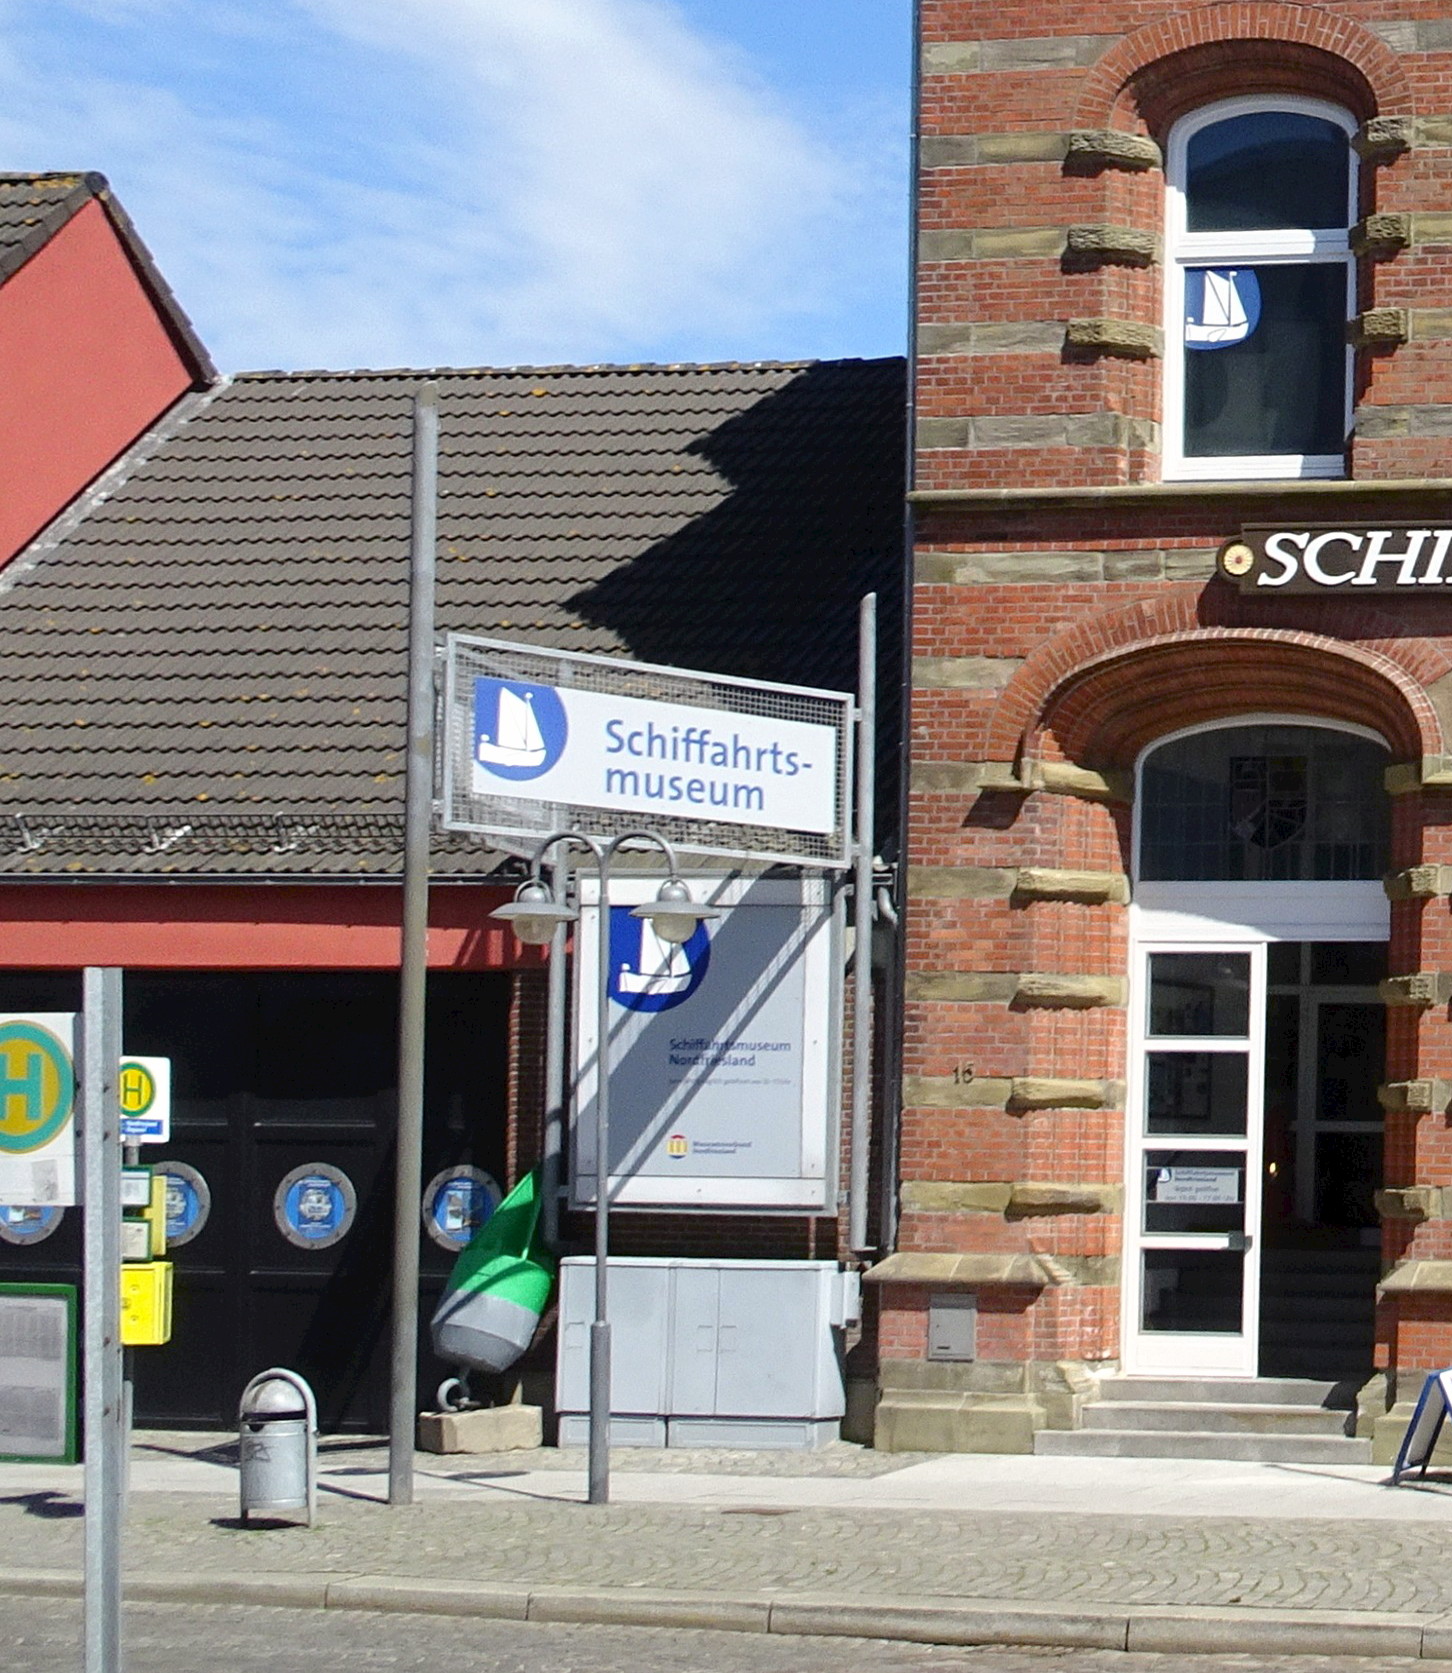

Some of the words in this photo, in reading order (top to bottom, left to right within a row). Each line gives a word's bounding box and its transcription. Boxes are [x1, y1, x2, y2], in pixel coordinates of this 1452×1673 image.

[605, 719, 813, 776] Schiffahrts-
[605, 767, 765, 811] museum
[0, 1053, 43, 1122] H
[123, 1073, 142, 1105] H
